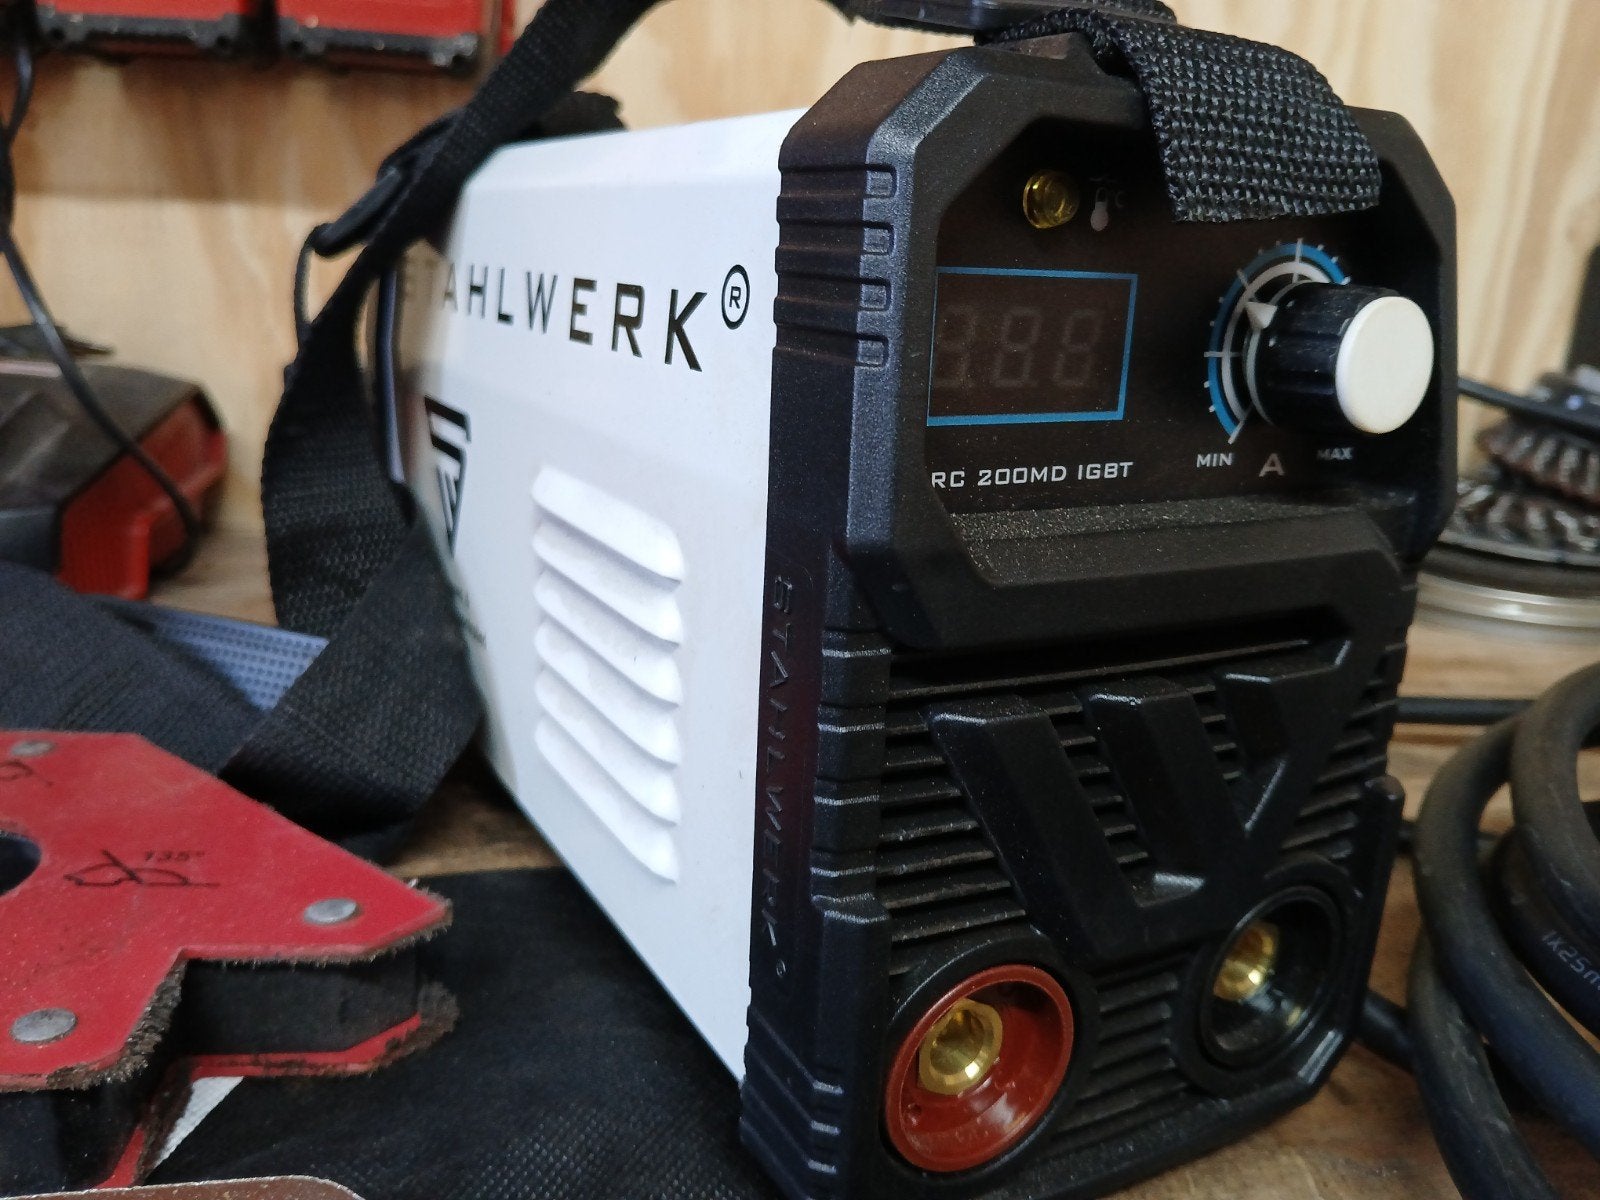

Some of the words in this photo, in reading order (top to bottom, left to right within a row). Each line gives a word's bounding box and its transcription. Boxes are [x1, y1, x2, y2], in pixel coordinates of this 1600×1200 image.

[1195, 453, 1233, 469] MIN
[1316, 446, 1354, 461] MAX
[931, 470, 966, 488] RC
[977, 465, 1067, 486] 200MD
[1077, 461, 1134, 480] IGBT
[1258, 453, 1285, 478] A
